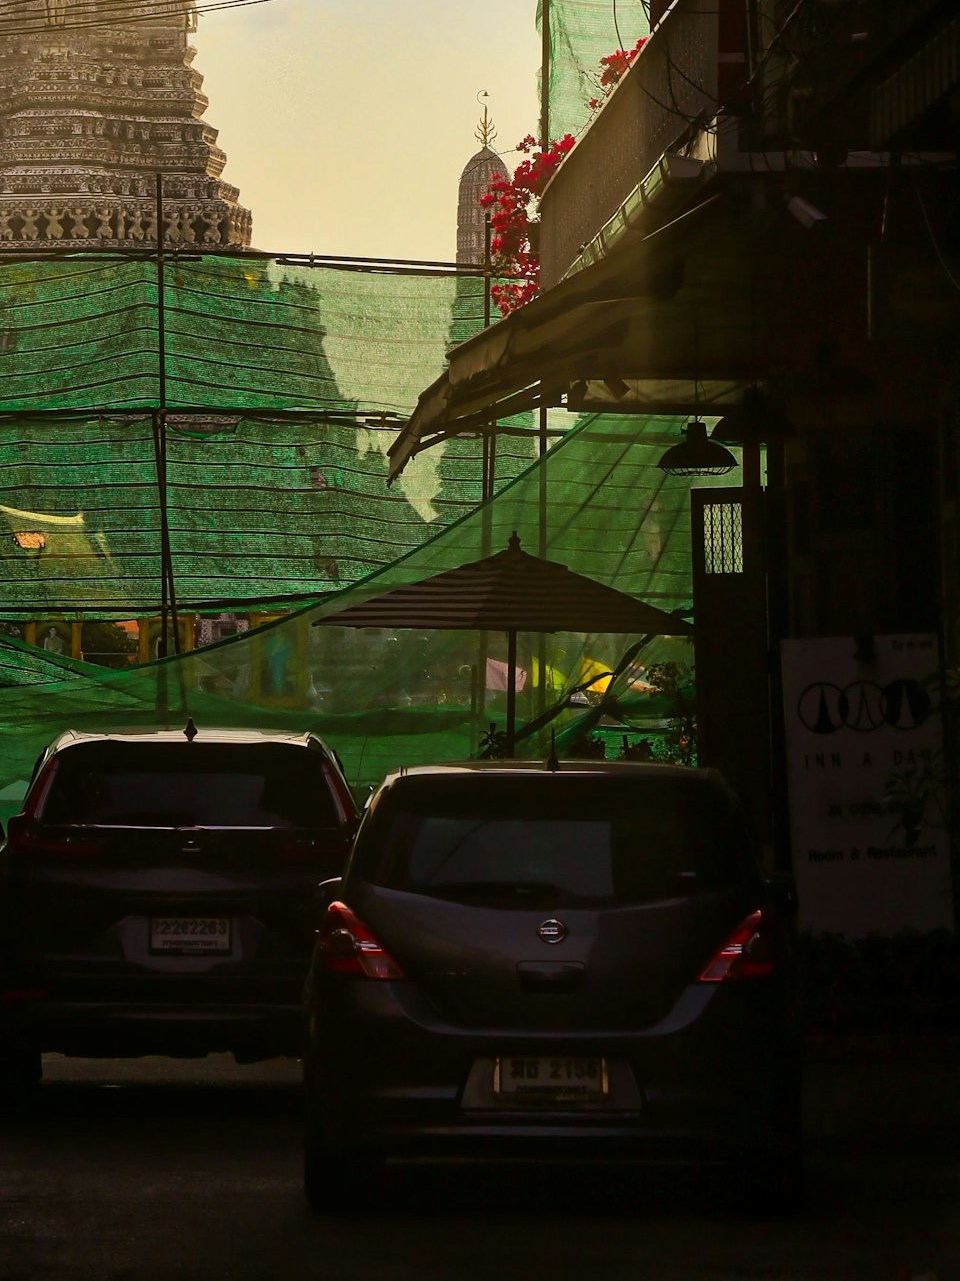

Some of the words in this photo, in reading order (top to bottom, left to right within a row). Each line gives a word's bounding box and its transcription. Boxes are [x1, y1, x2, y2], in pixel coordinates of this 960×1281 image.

[805, 752, 841, 769] INN
[863, 751, 872, 766] A
[894, 749, 924, 766] DA
[808, 848, 843, 863] Room
[850, 847, 860, 860] &
[867, 845, 937, 860] Restaurant
